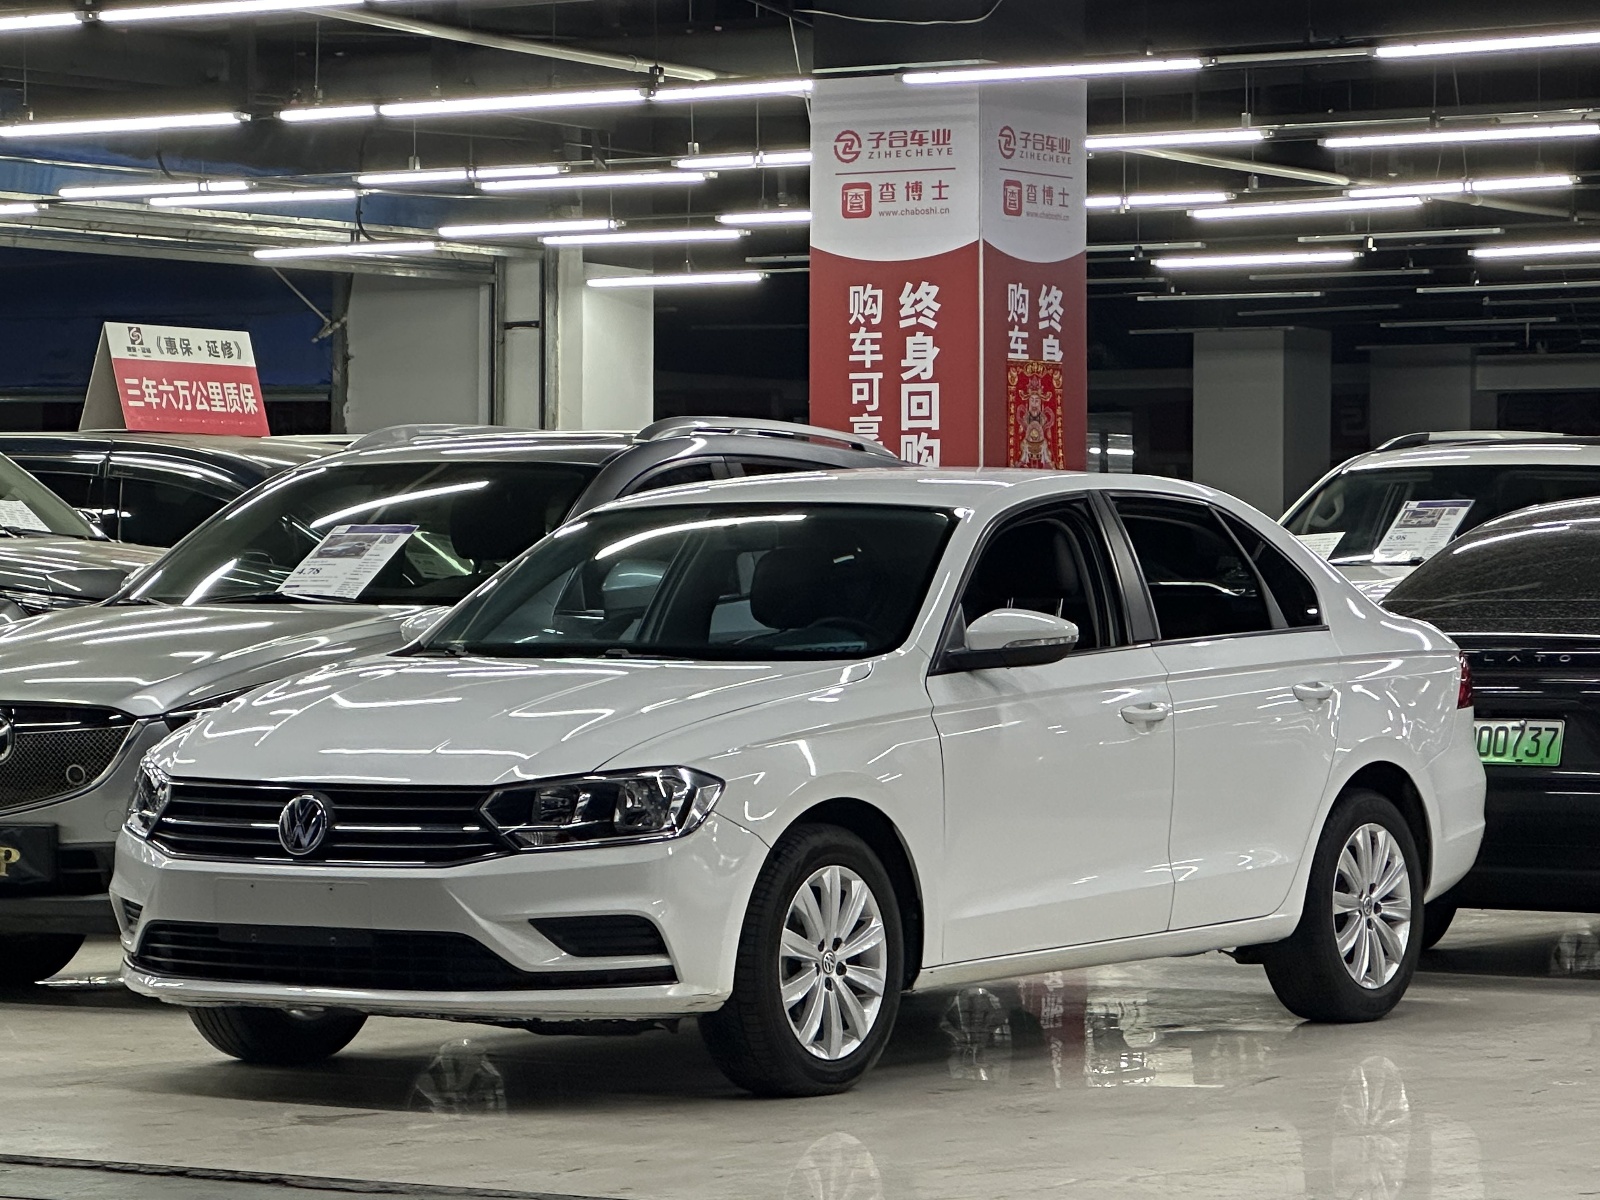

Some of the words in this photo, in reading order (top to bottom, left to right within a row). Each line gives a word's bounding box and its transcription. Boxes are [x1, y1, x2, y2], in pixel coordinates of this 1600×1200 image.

[867, 128, 951, 149] 子合车业
[1020, 131, 1071, 155] 子合车业
[868, 147, 953, 160] ZIHECHEYE
[1020, 150, 1072, 165] ZIHECHEYE
[878, 180, 949, 203] 查博士
[1026, 184, 1070, 208] 查博士
[878, 207, 950, 217] www.chaboshi.cn
[1007, 283, 1029, 360] 购车
[898, 281, 942, 468] 终身回购
[124, 377, 259, 415] 三年六万公里质保
[296, 567, 323, 575] 4.78
[1474, 725, 1559, 758] 00737
